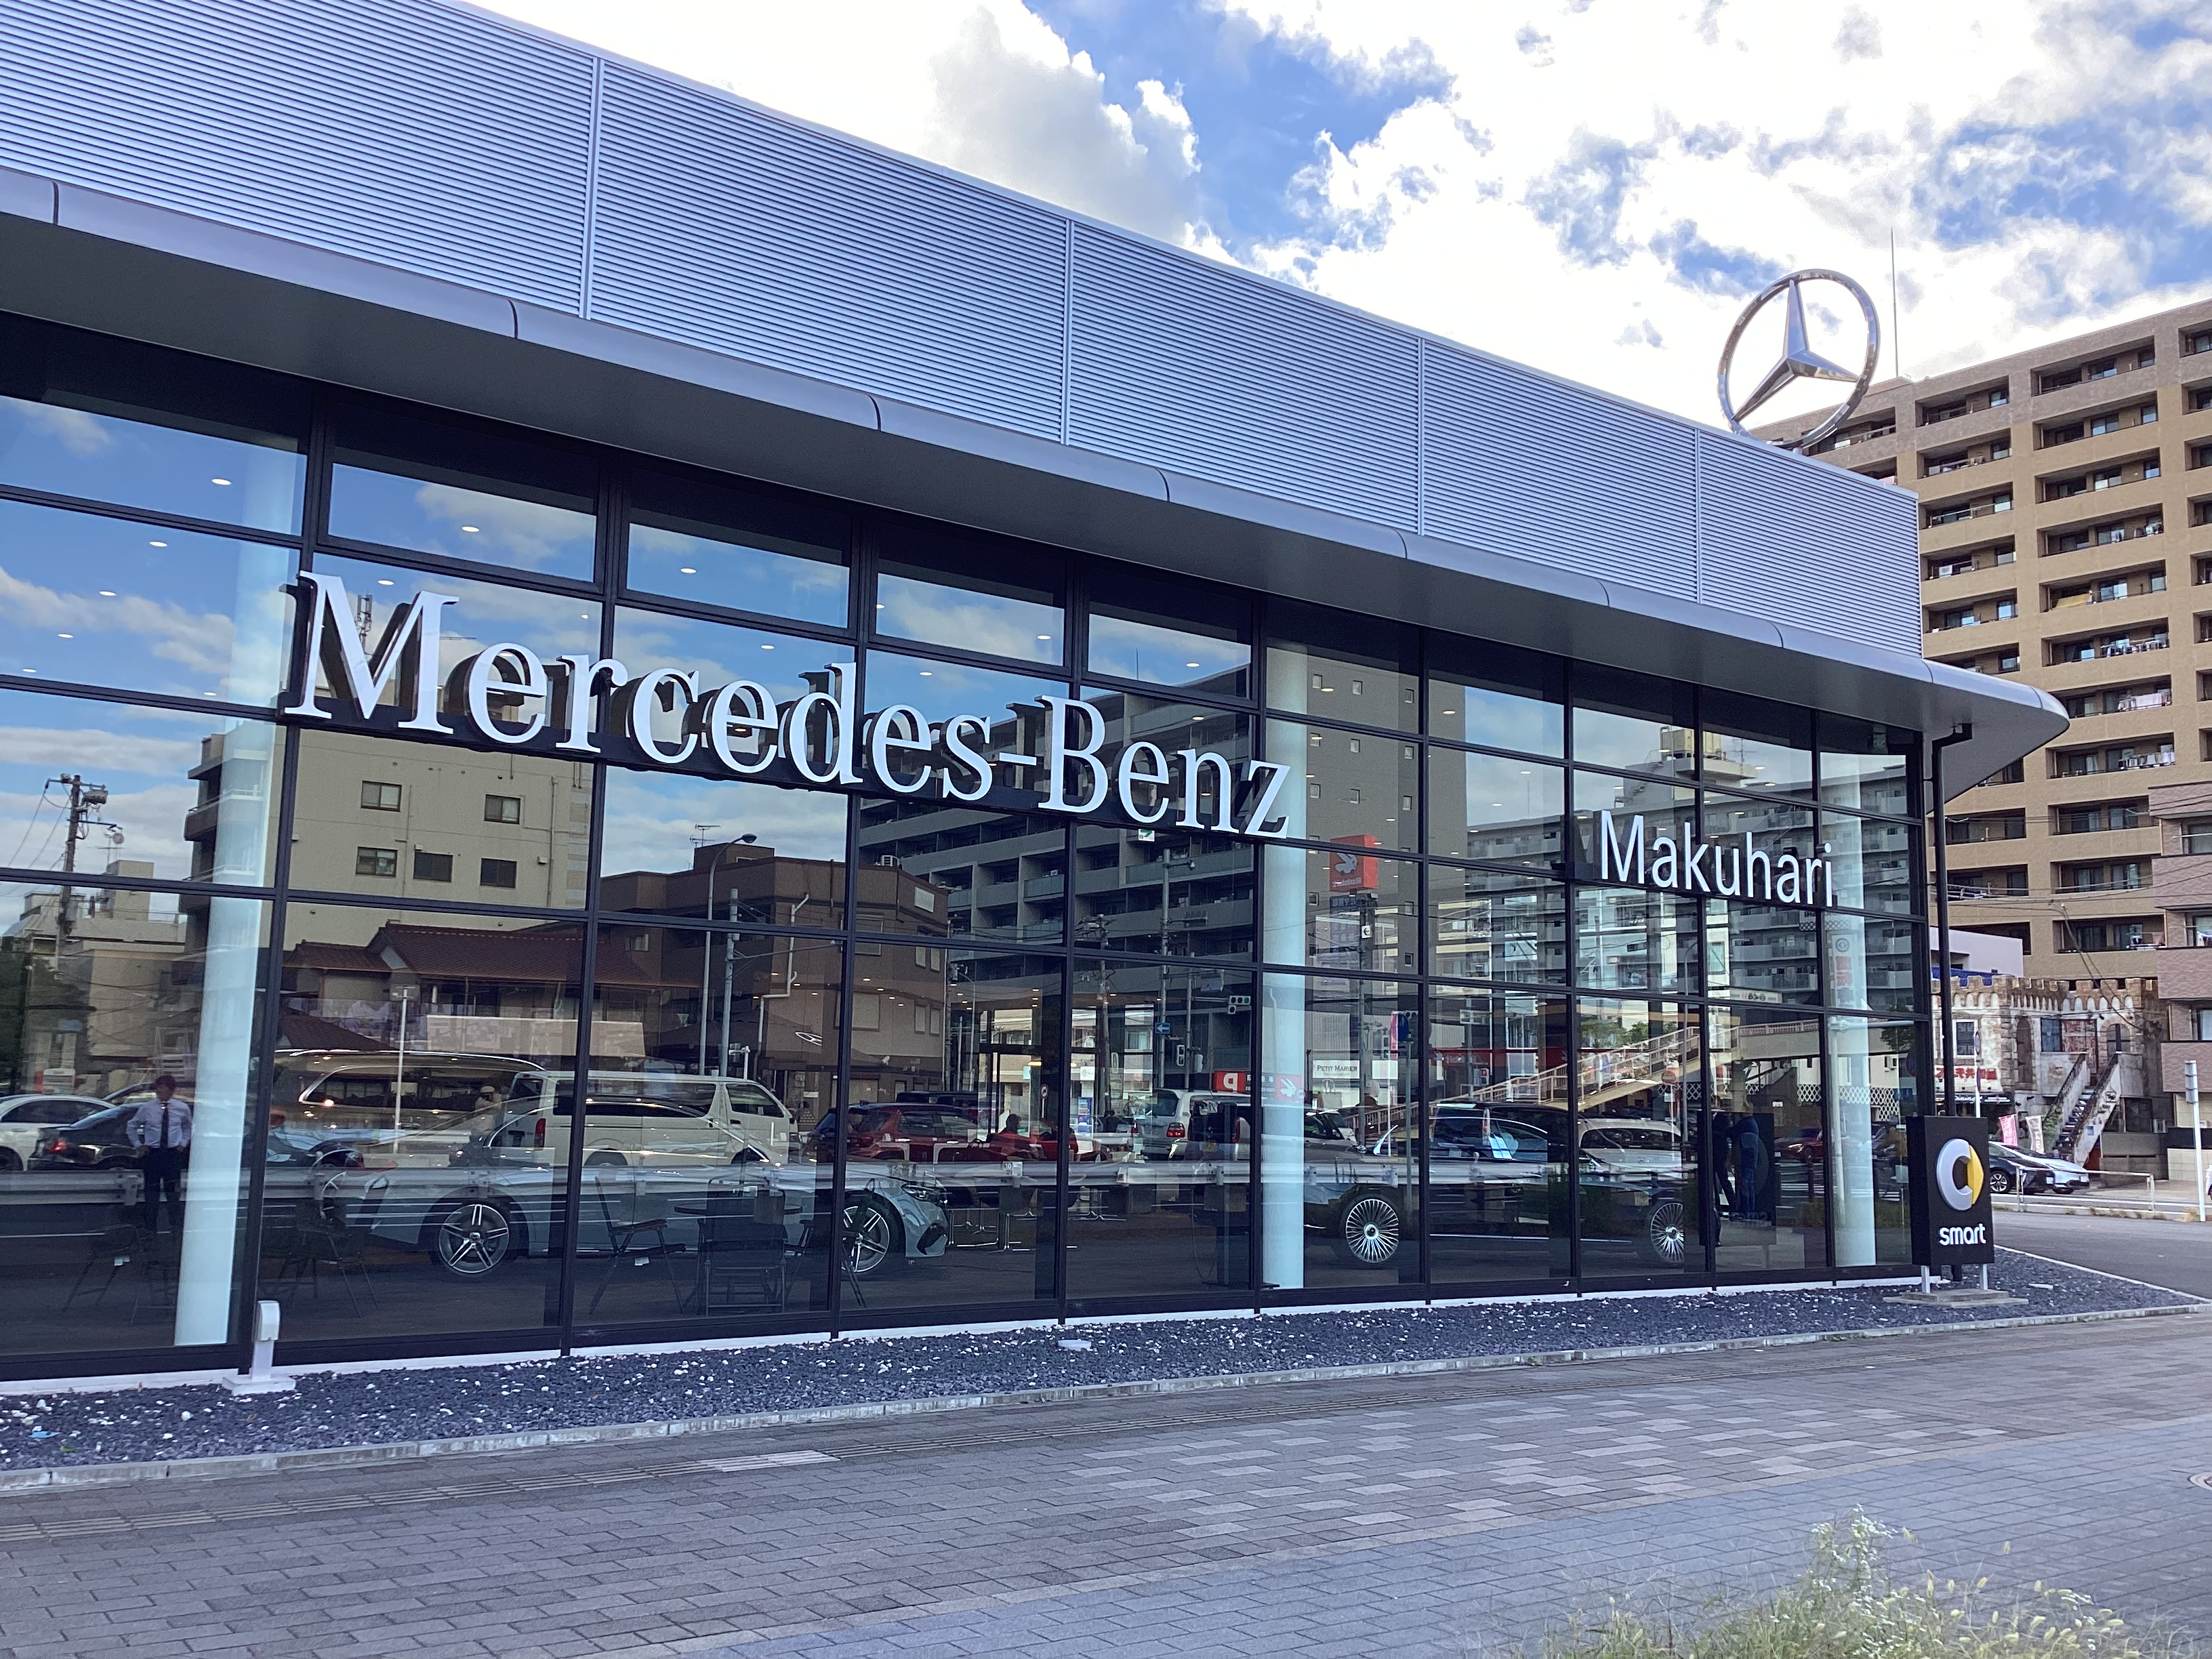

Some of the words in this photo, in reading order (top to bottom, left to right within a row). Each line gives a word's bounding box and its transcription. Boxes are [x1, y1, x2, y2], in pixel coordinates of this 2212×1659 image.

[284, 571, 1290, 838] Mercedes-Benz
[1601, 809, 1833, 907] Makuhari
[1939, 1223, 1986, 1246] smart
